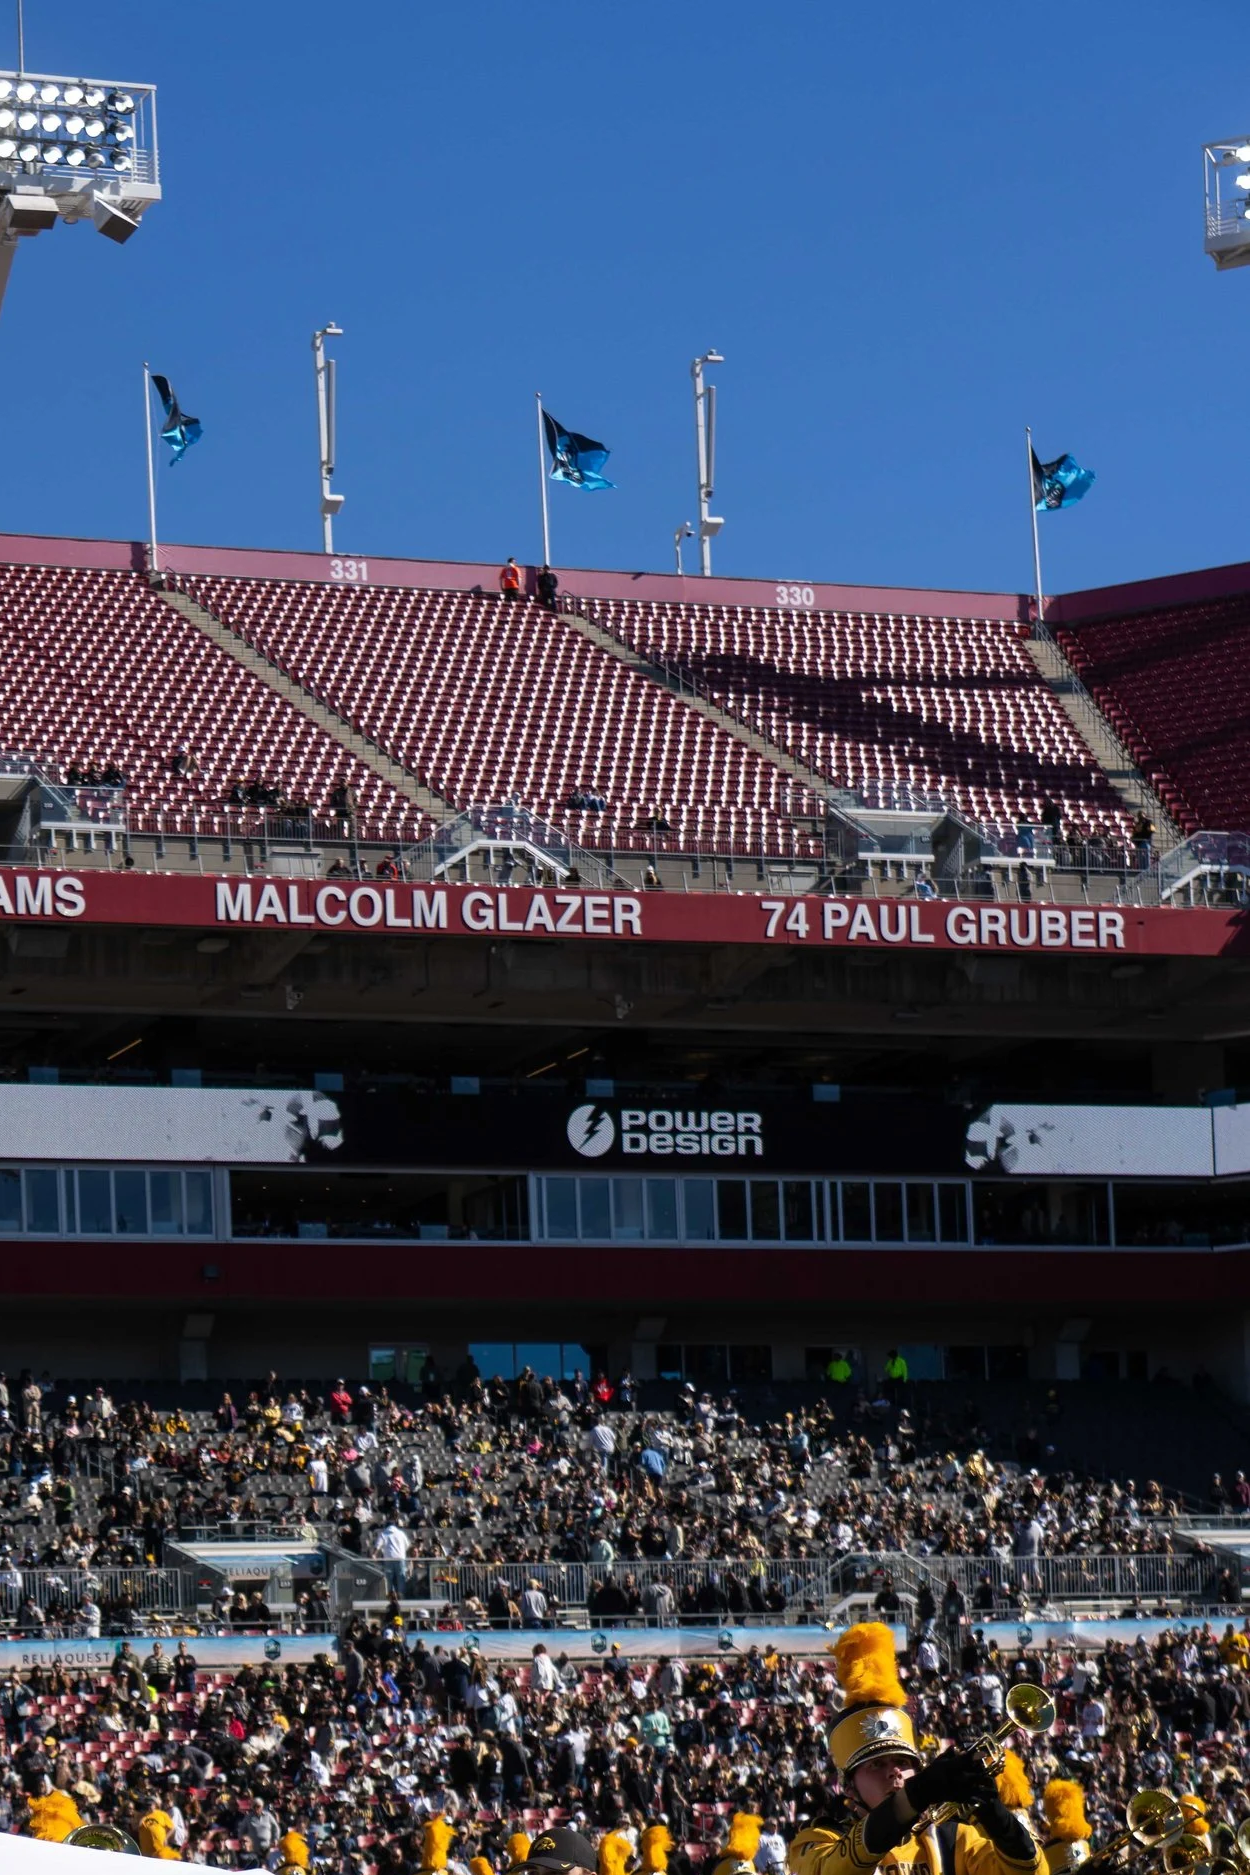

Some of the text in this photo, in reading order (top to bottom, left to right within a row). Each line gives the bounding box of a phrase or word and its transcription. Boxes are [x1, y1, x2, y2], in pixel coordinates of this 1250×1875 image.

[330, 559, 369, 581] 331
[776, 586, 815, 607] 330
[216, 882, 643, 936] MALCOLM GLAZER
[761, 901, 1126, 949] 74 PAUL GRUBER
[22, 1652, 110, 1665] RELIAQUEST
